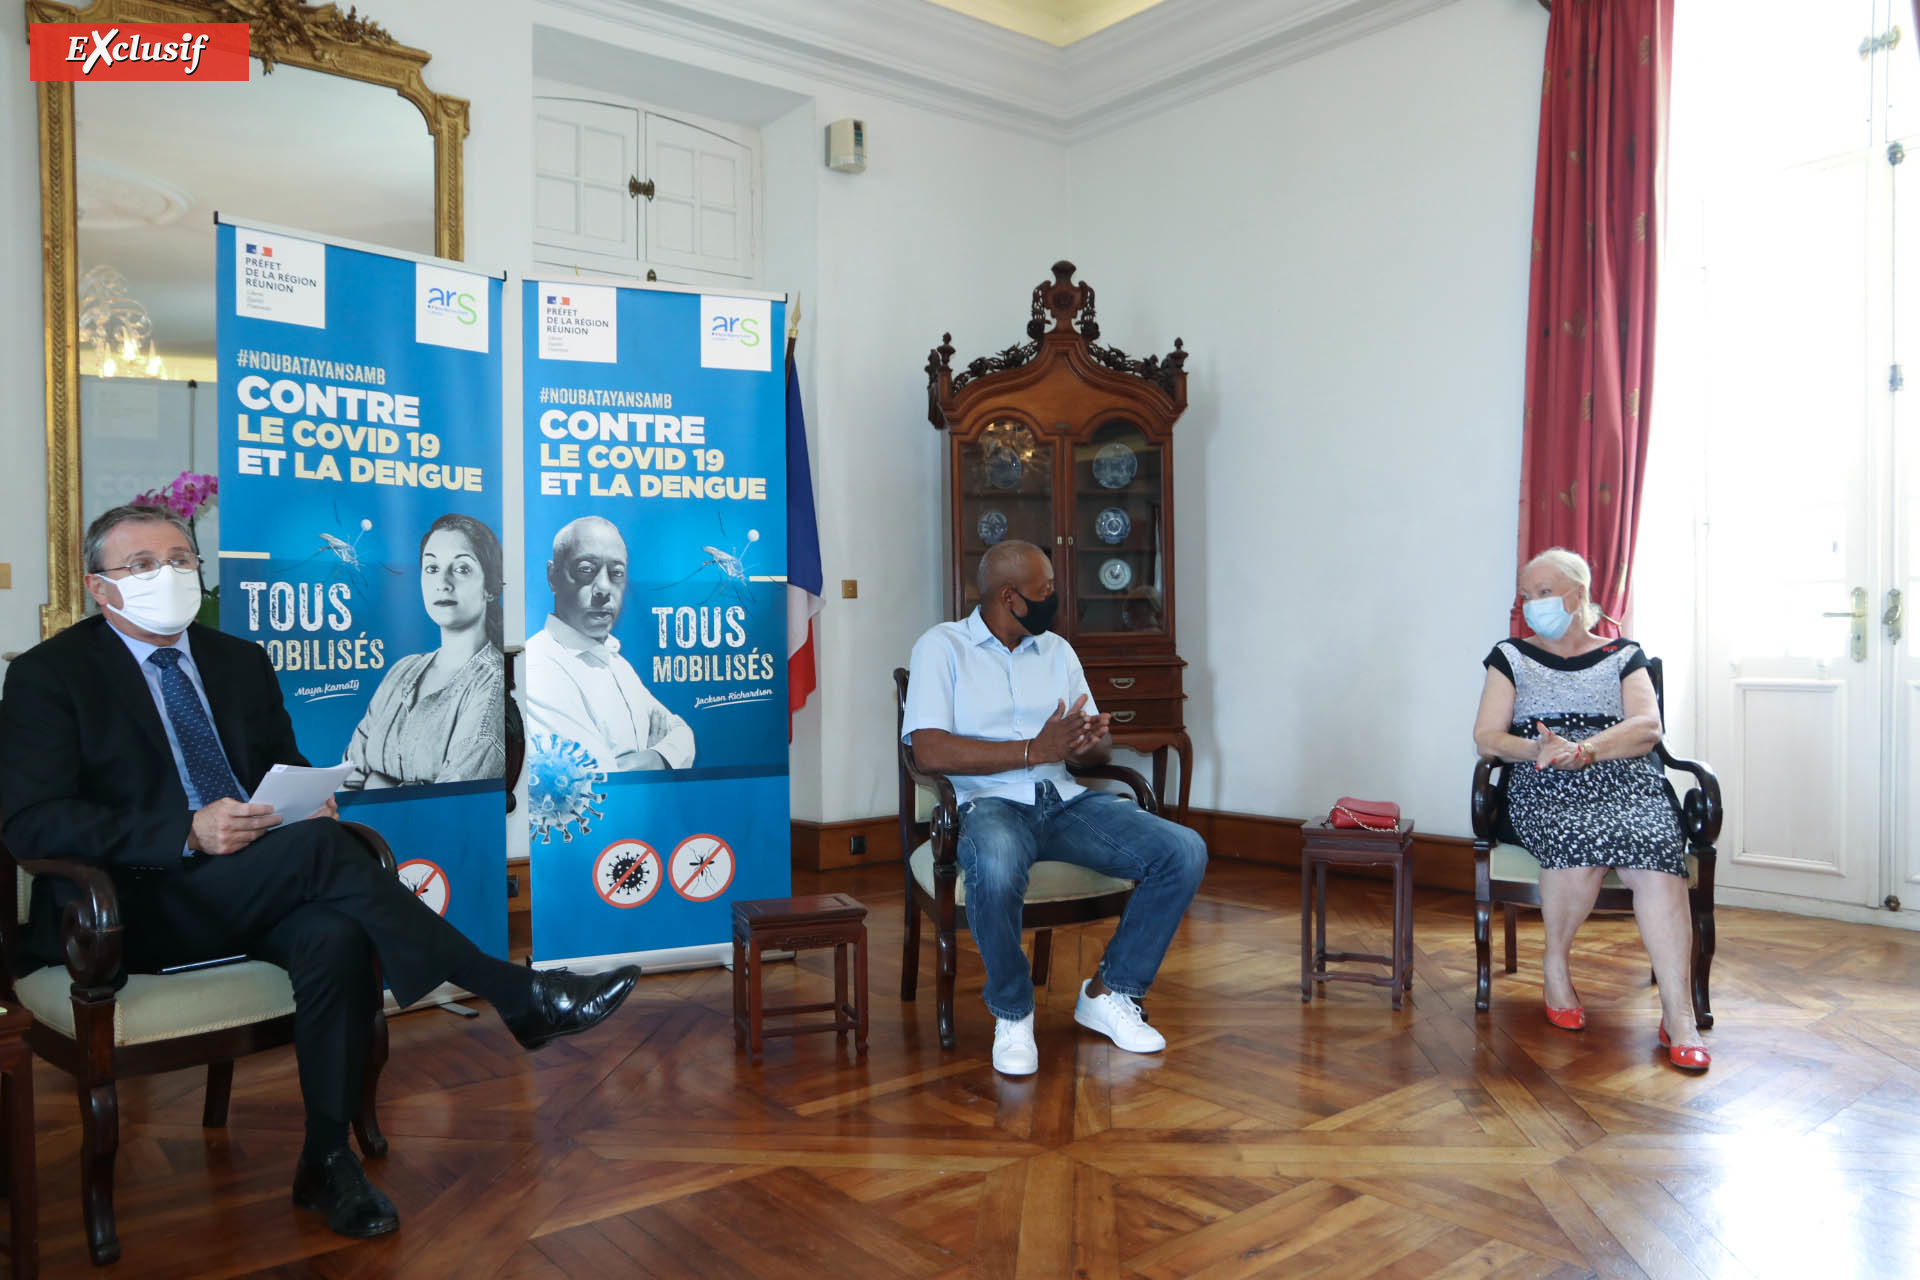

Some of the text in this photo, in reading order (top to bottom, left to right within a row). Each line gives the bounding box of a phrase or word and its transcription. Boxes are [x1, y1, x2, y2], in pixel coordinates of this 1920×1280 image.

[245, 257, 281, 271] PRÉFET
[245, 267, 317, 288] DE LA RÉGION
[245, 277, 294, 293] RÉUNION
[546, 306, 578, 317] PRÉFET
[547, 316, 609, 328] DE LA RÉGION
[547, 324, 589, 335] RÉUNION
[237, 349, 387, 385] #NOUBATAYANSAMB
[237, 375, 420, 427] CONTRE
[539, 387, 673, 409] #NOUBATAYANSAMB
[238, 413, 441, 459] LE COVID 19
[539, 409, 706, 444] CONTRE
[238, 446, 483, 492] ET LA DENGUE
[540, 443, 725, 472] LE COVID 19
[540, 472, 767, 500] ET LA DENGUE
[240, 581, 352, 632] TOUS
[652, 606, 746, 649] TOUS
[256, 631, 385, 672] OBILISÉS
[653, 648, 774, 683] MOBILISÉS
[295, 686, 323, 697] Maya
[694, 688, 773, 708] Jackson Richardson
